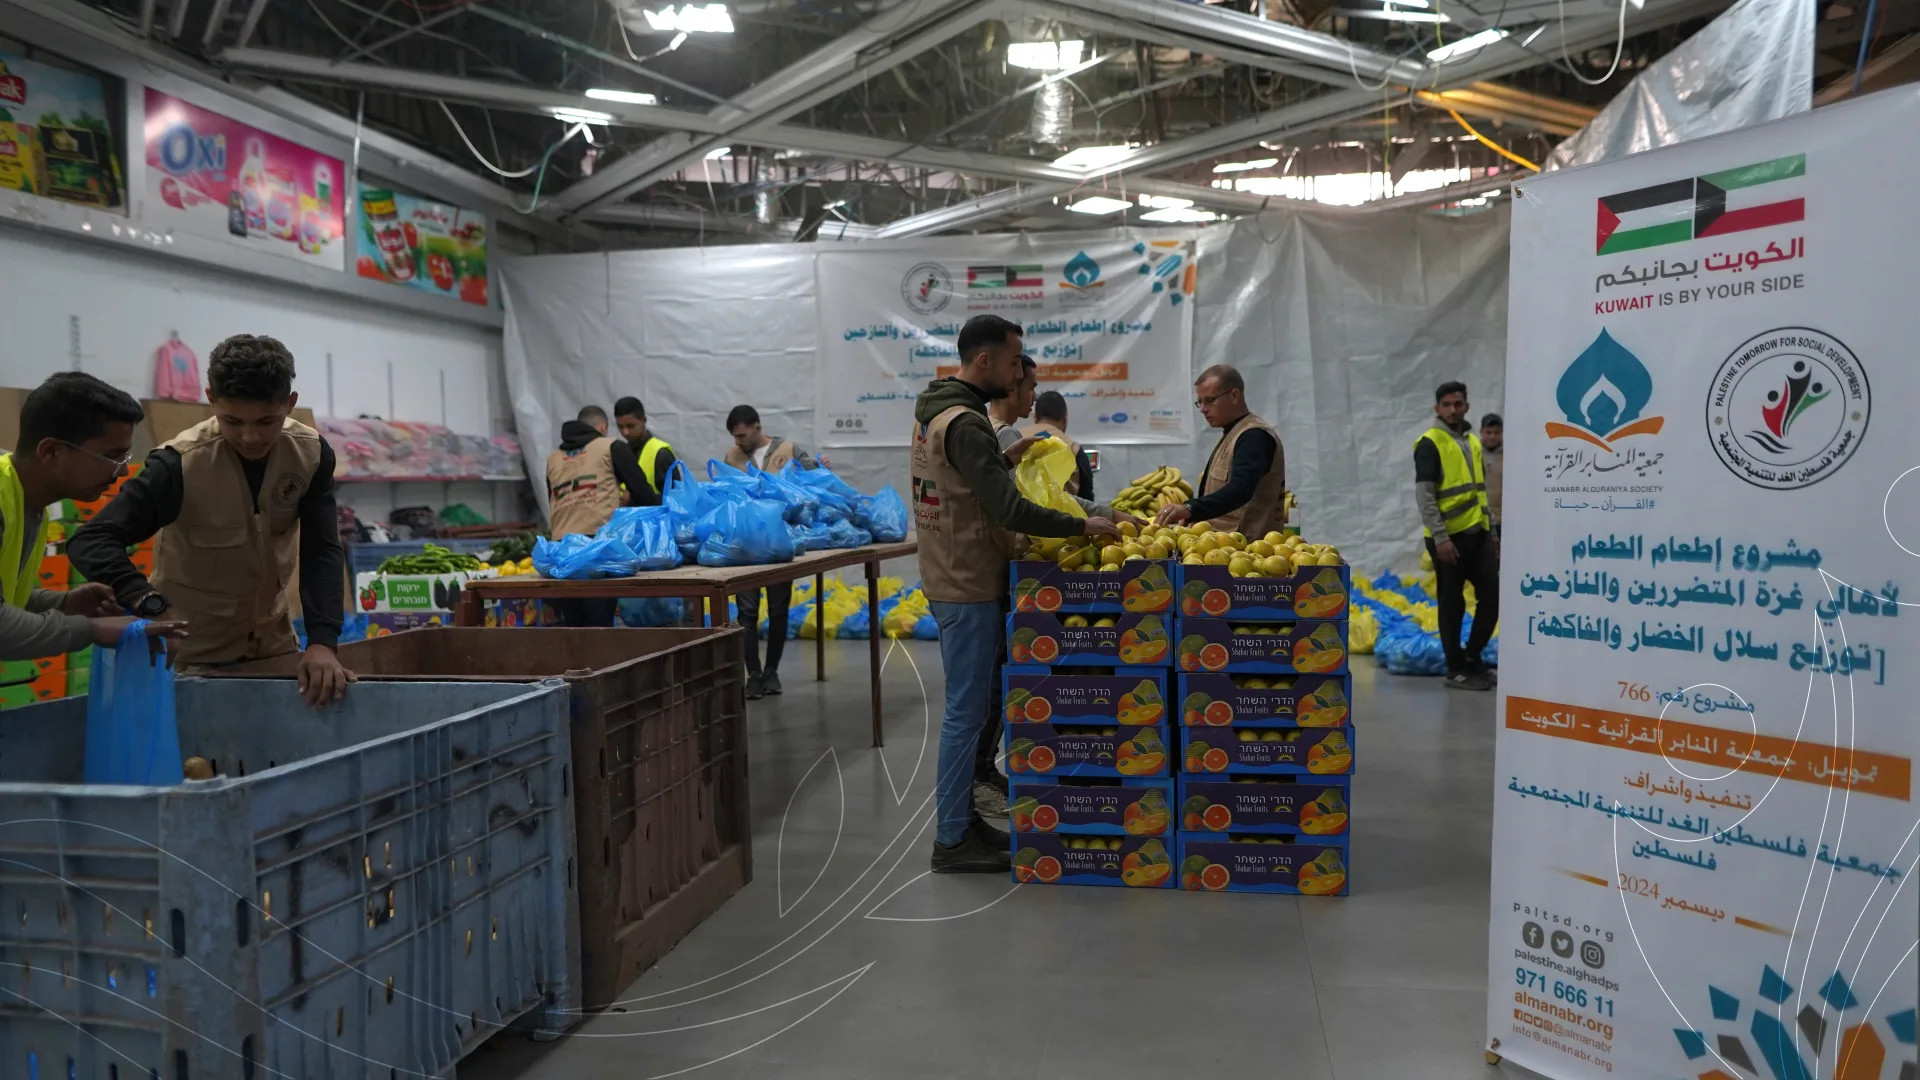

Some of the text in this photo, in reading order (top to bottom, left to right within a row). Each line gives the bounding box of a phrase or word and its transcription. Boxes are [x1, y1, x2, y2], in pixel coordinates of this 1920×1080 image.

[161, 124, 225, 171] Oxi
[1595, 237, 1804, 293] الكويت بجانبكم
[1595, 274, 1805, 314] KUWAIT IS BY YOUR SIDE
[1715, 336, 1862, 407] PALESTINE TOMORROW FOR SOCIAL DEVELOPMENT
[1798, 457, 1832, 482] فلسطين
[1572, 533, 1822, 573] مشروع إطعام الطعام
[392, 596, 427, 605] מובחרים
[397, 584, 420, 594] ירקות
[1064, 582, 1120, 590] הדרי השחר
[1234, 584, 1292, 593] הדרי השחר
[1520, 569, 1899, 627] لأهالي غزة المتضررين والنازحين
[1061, 631, 1117, 639] הדרי השחר
[1232, 639, 1290, 647] הדרי השחר
[1528, 611, 1622, 650] والفاكهة]
[1627, 620, 1703, 654] الخضار
[1713, 628, 1778, 662] سلال
[1056, 688, 1111, 696] הדרי השחר
[1236, 697, 1294, 705] הדרי השחר
[1618, 681, 1755, 713] مشروع رقم: 766
[1521, 711, 1576, 730] الكويت
[1598, 718, 1664, 745] القرآنية
[1058, 741, 1114, 751] הדרי השחר
[1239, 745, 1269, 753] השחר
[1669, 736, 1718, 753] المنابر
[1726, 740, 1797, 771] جمعية
[1808, 755, 1879, 785] تمويل:
[1064, 796, 1118, 805] הדרי השחר
[1236, 795, 1293, 804] הדרי השחר
[1695, 784, 1752, 811] تنفيذ
[1508, 776, 1902, 885] جمعية فلسطين الغد للتنمية المجتمعية
[1064, 852, 1120, 861] הדרי השחר
[1235, 855, 1292, 865] הדרי השחר
[1632, 839, 1717, 871] فلسطين
[1617, 873, 1725, 922] ديسمبر 2024
[1515, 949, 1620, 992] palestine.alghadps
[1516, 967, 1613, 1018] 971 666 11
[1515, 991, 1613, 1040] almanabr.org
[1512, 1023, 1613, 1073] info@almanabr.org
[1553, 1023, 1612, 1054] @almanabr
